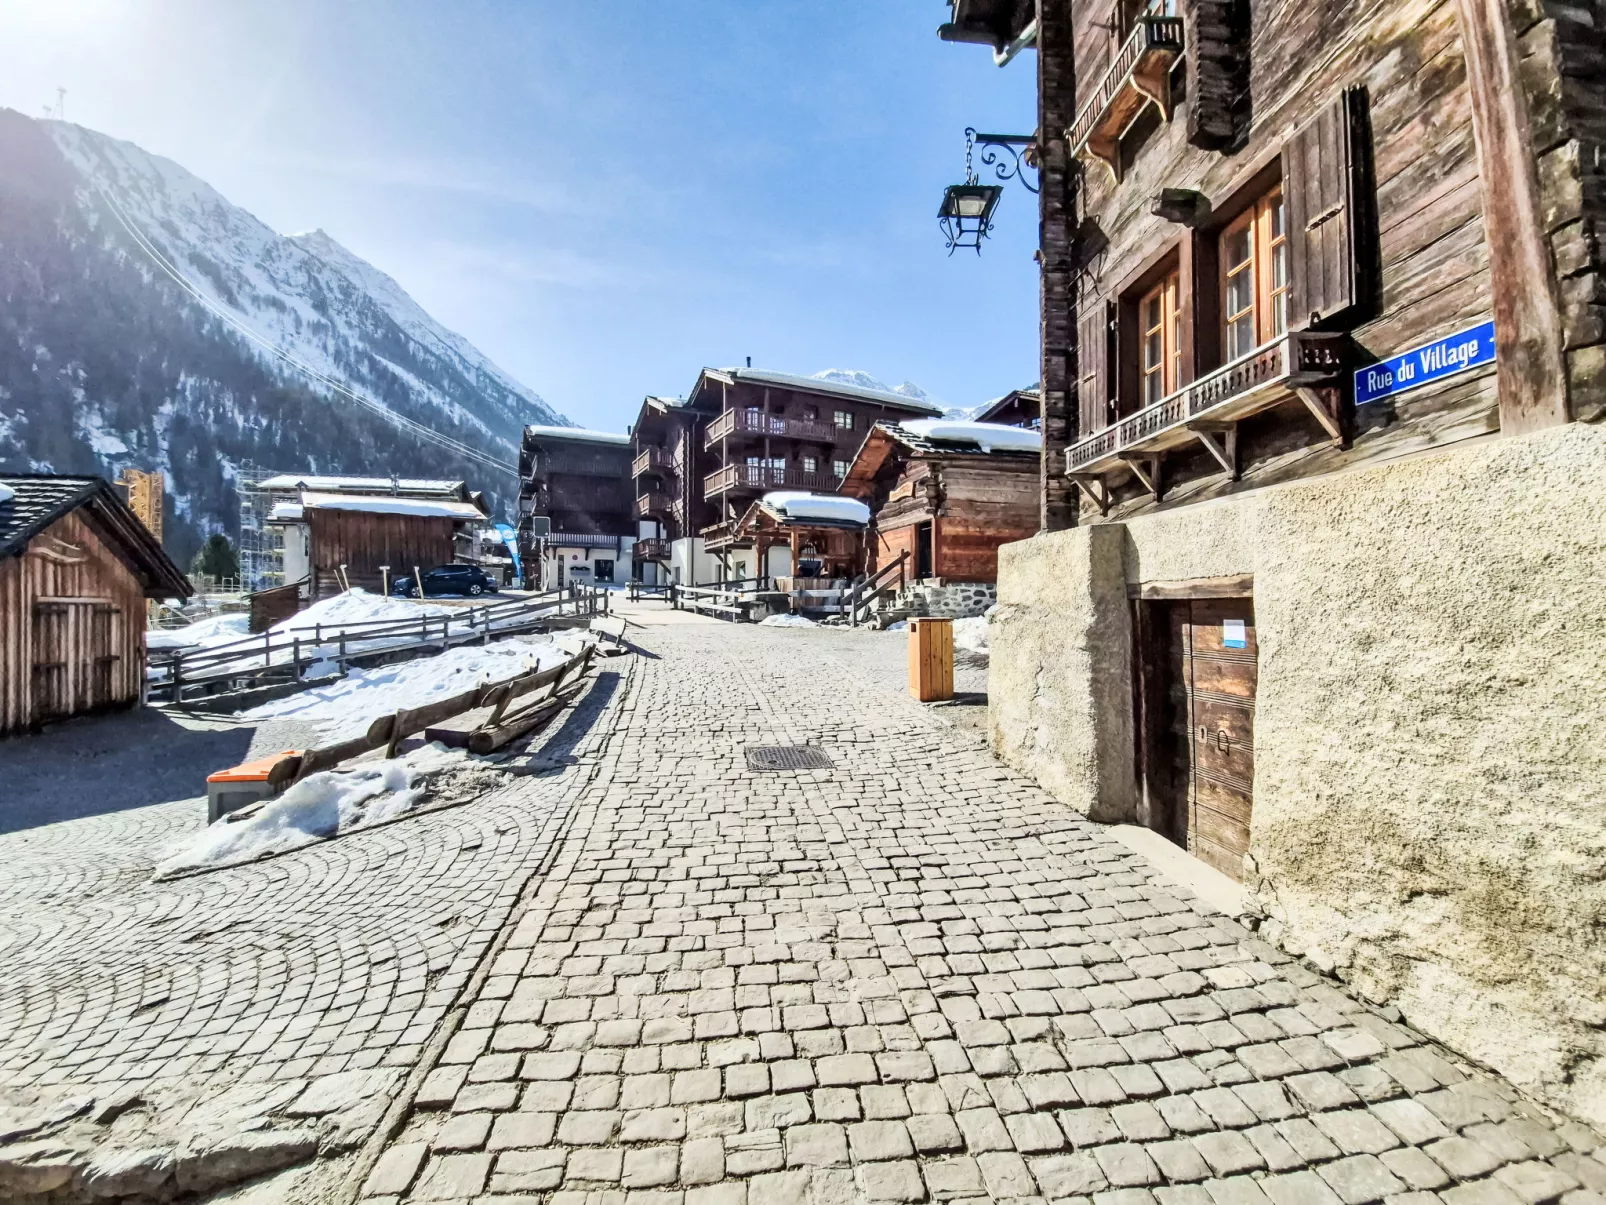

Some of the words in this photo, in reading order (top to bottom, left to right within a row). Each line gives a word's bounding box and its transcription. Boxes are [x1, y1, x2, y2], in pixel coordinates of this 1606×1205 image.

[1367, 370, 1393, 393] Rue
[1397, 358, 1415, 382] du
[1420, 339, 1479, 374] Village
